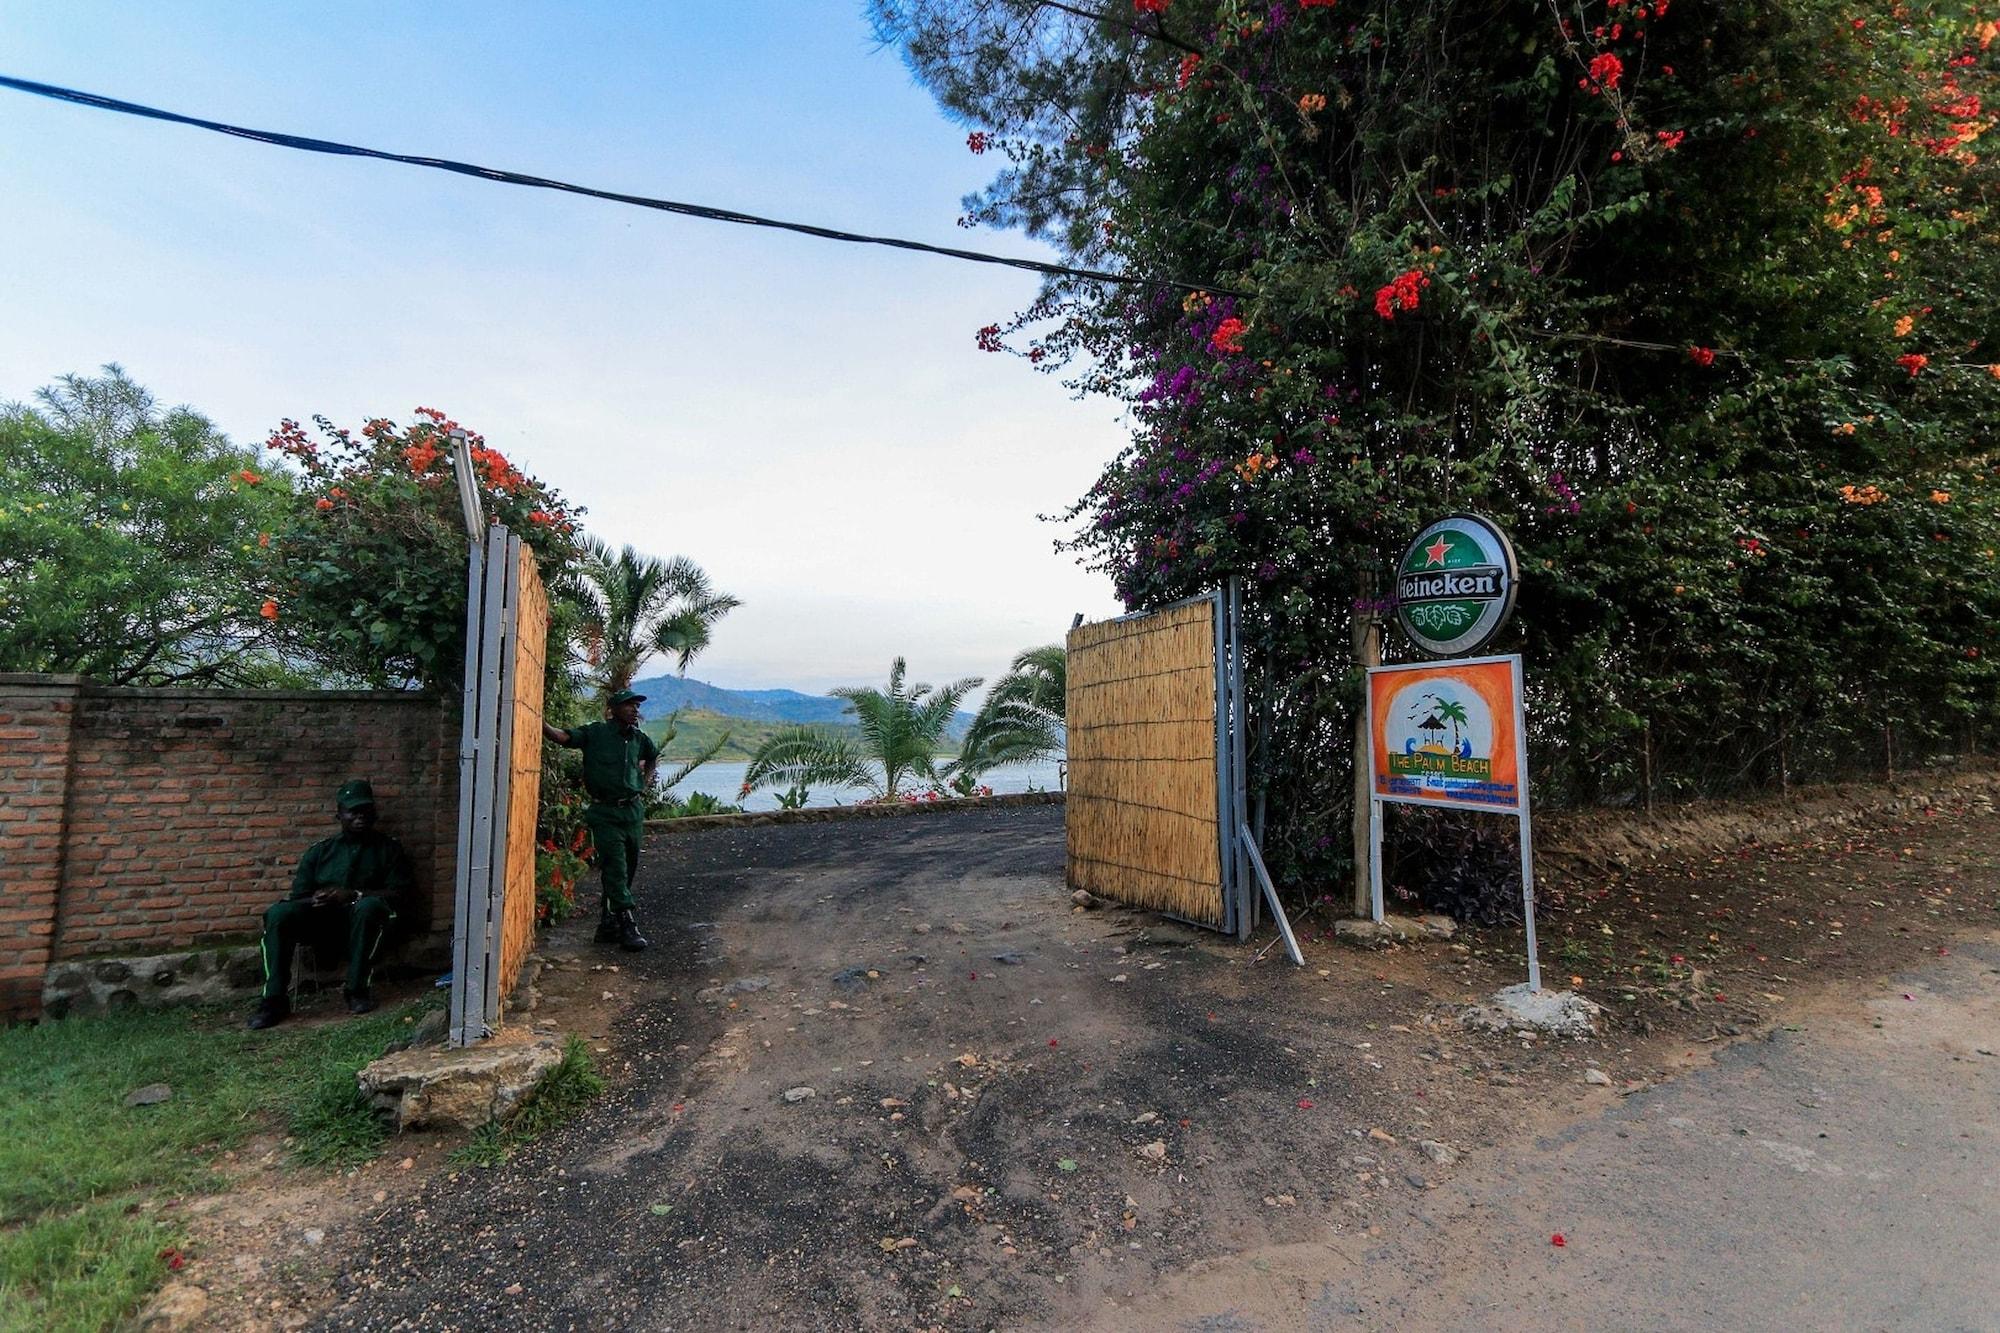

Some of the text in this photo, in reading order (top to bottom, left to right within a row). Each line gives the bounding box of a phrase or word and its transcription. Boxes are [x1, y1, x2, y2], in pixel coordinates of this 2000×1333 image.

[1400, 573, 1496, 599] Heineken
[1390, 752, 1410, 769] THE
[1414, 752, 1445, 771] PALM
[1451, 754, 1488, 774] BEACH
